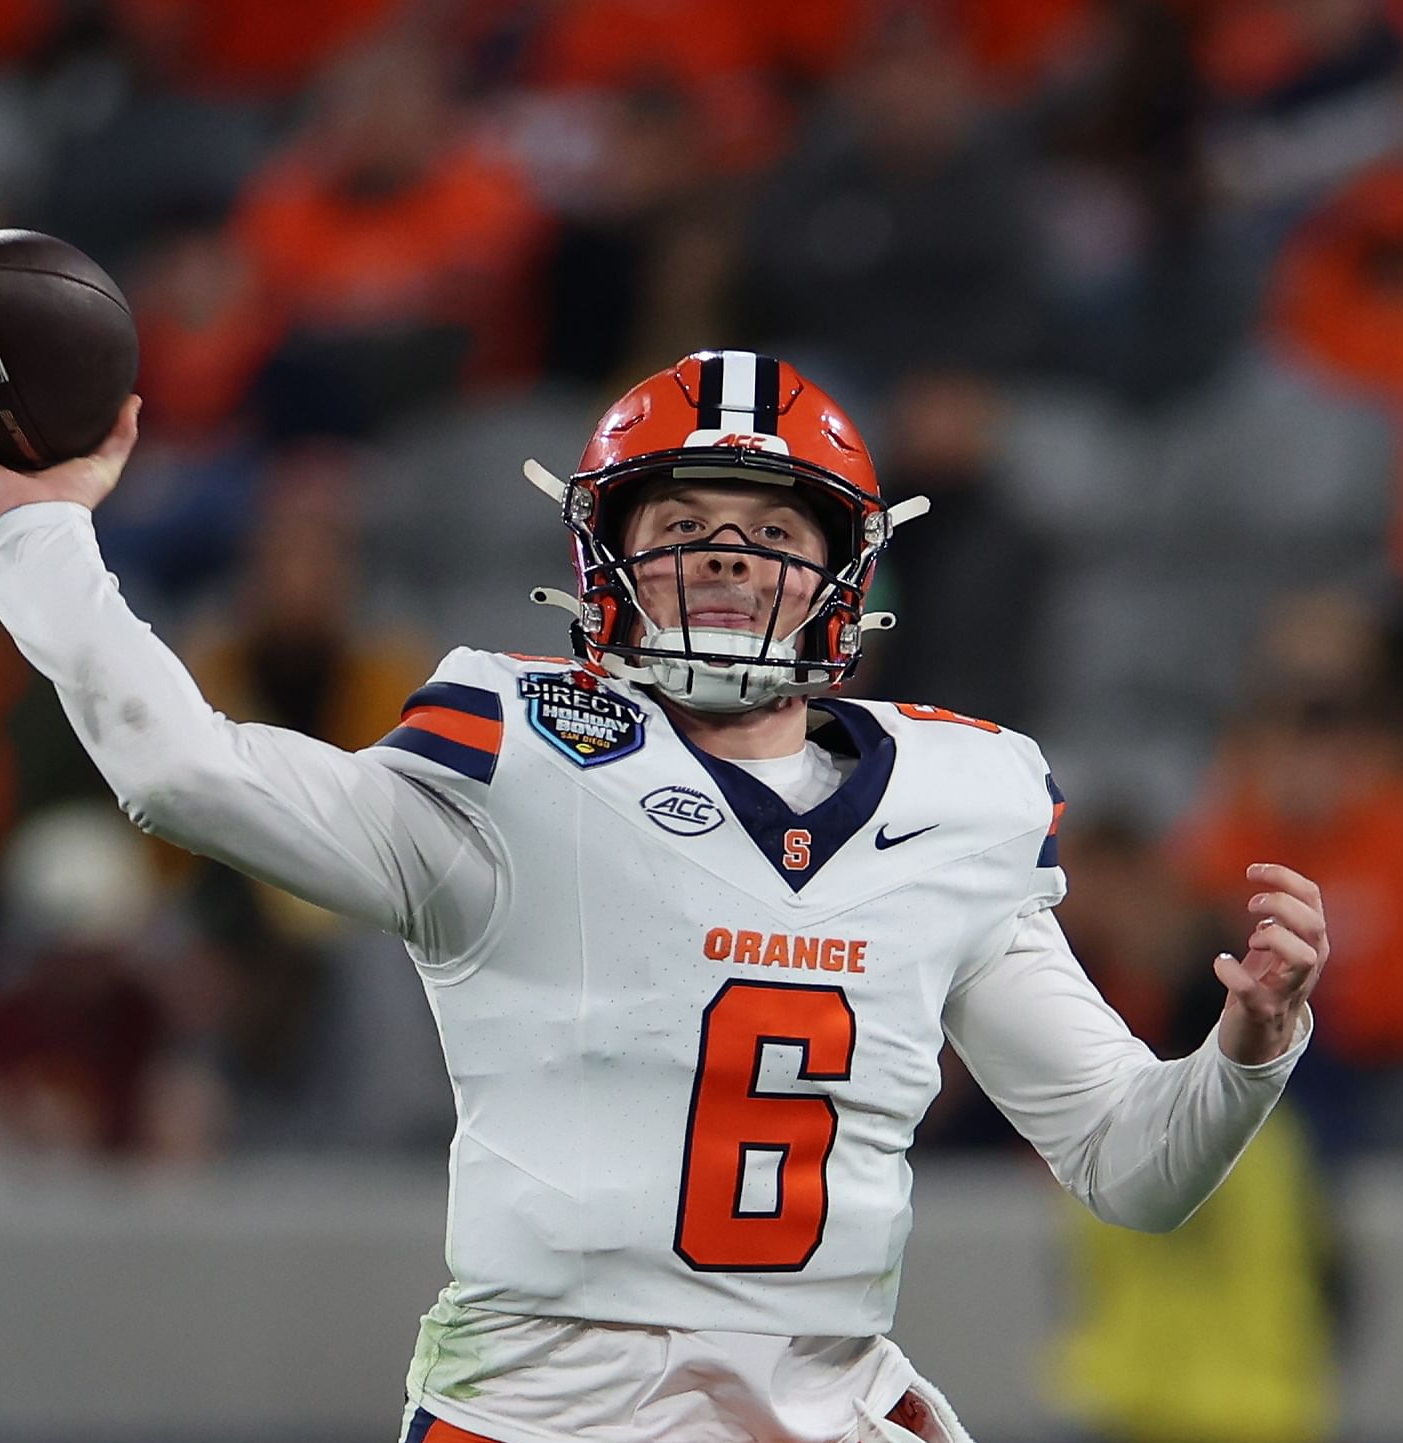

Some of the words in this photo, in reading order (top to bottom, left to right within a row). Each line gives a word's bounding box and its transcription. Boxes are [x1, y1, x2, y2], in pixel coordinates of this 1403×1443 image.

[521, 680, 645, 724] DIRECTV
[542, 704, 630, 733] HOLIDAY
[555, 718, 618, 743] BOWL
[560, 731, 580, 741] SAN
[582, 735, 610, 749] DIEGO
[653, 796, 716, 821] ACC
[782, 828, 812, 870] S
[703, 927, 868, 973] ORANGE
[673, 977, 856, 1272] 6
